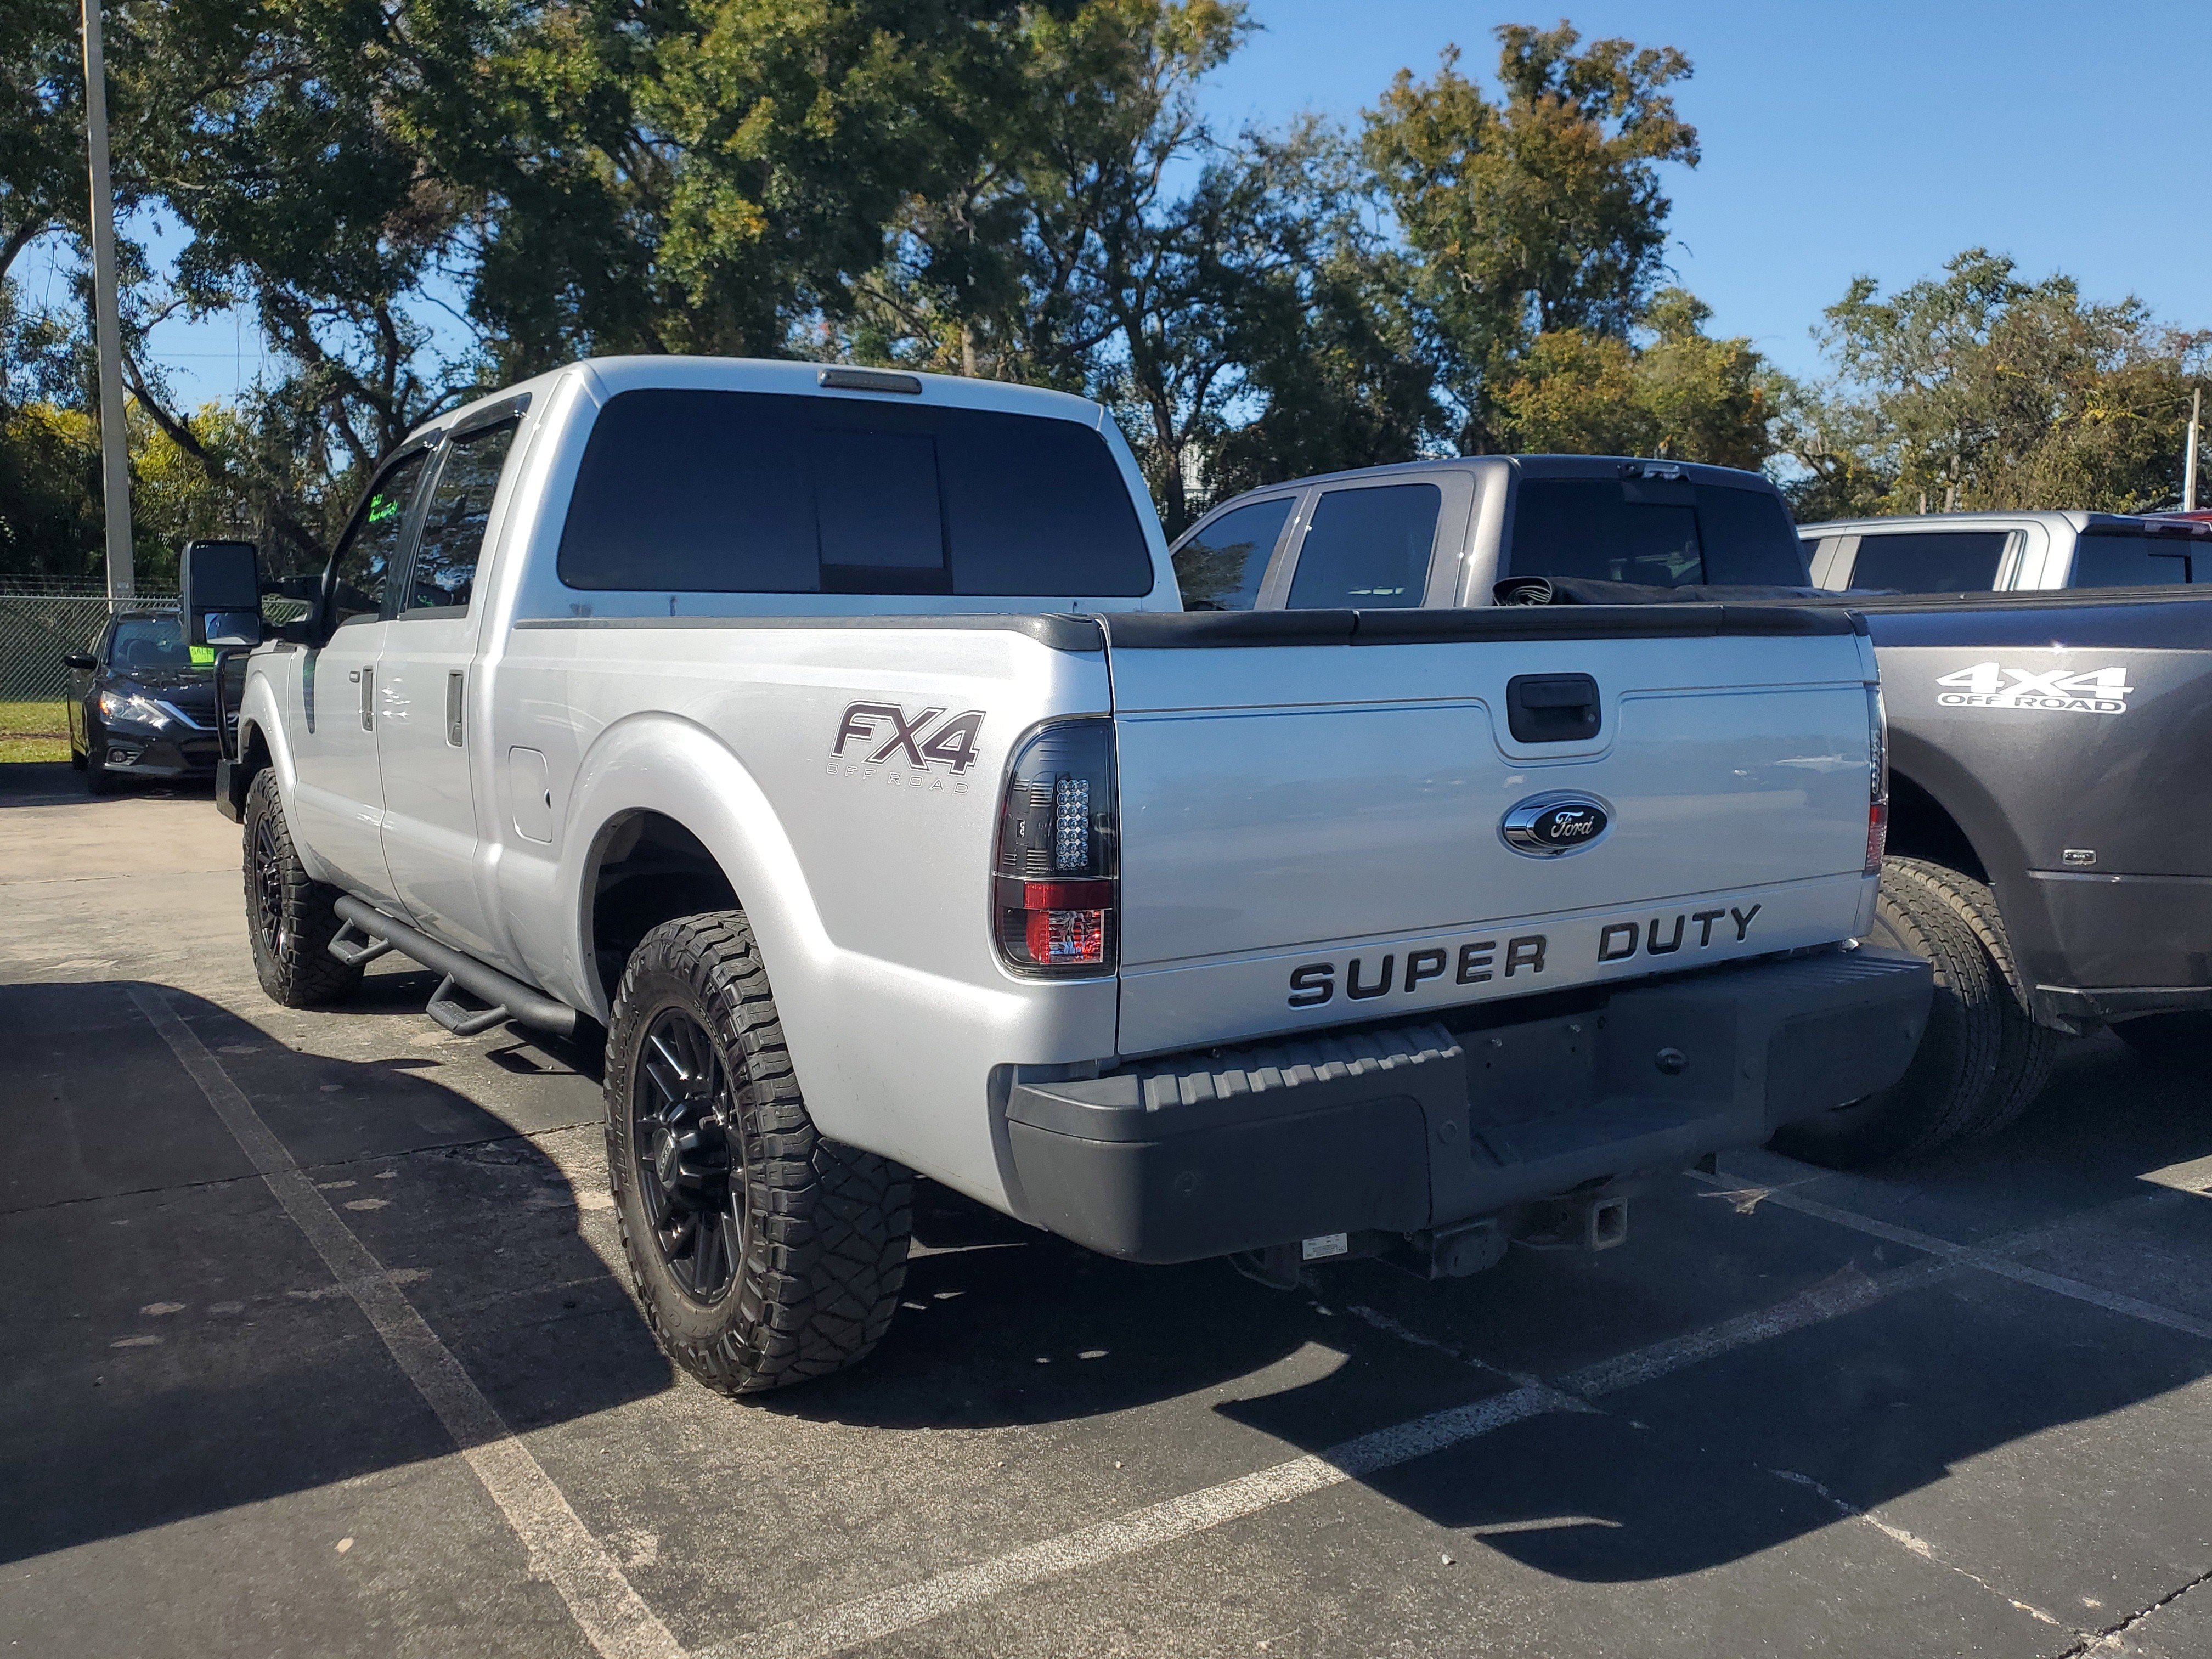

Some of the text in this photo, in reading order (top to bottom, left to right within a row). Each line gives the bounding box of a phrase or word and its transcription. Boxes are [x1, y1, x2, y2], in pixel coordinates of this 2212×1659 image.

[1941, 695, 2123, 712] OFF ROAD
[829, 698, 987, 777] FX4
[826, 762, 969, 795] OFF ROAD
[1550, 811, 1595, 838] Ford
[1288, 903, 1763, 1010] SUPER DUTY
